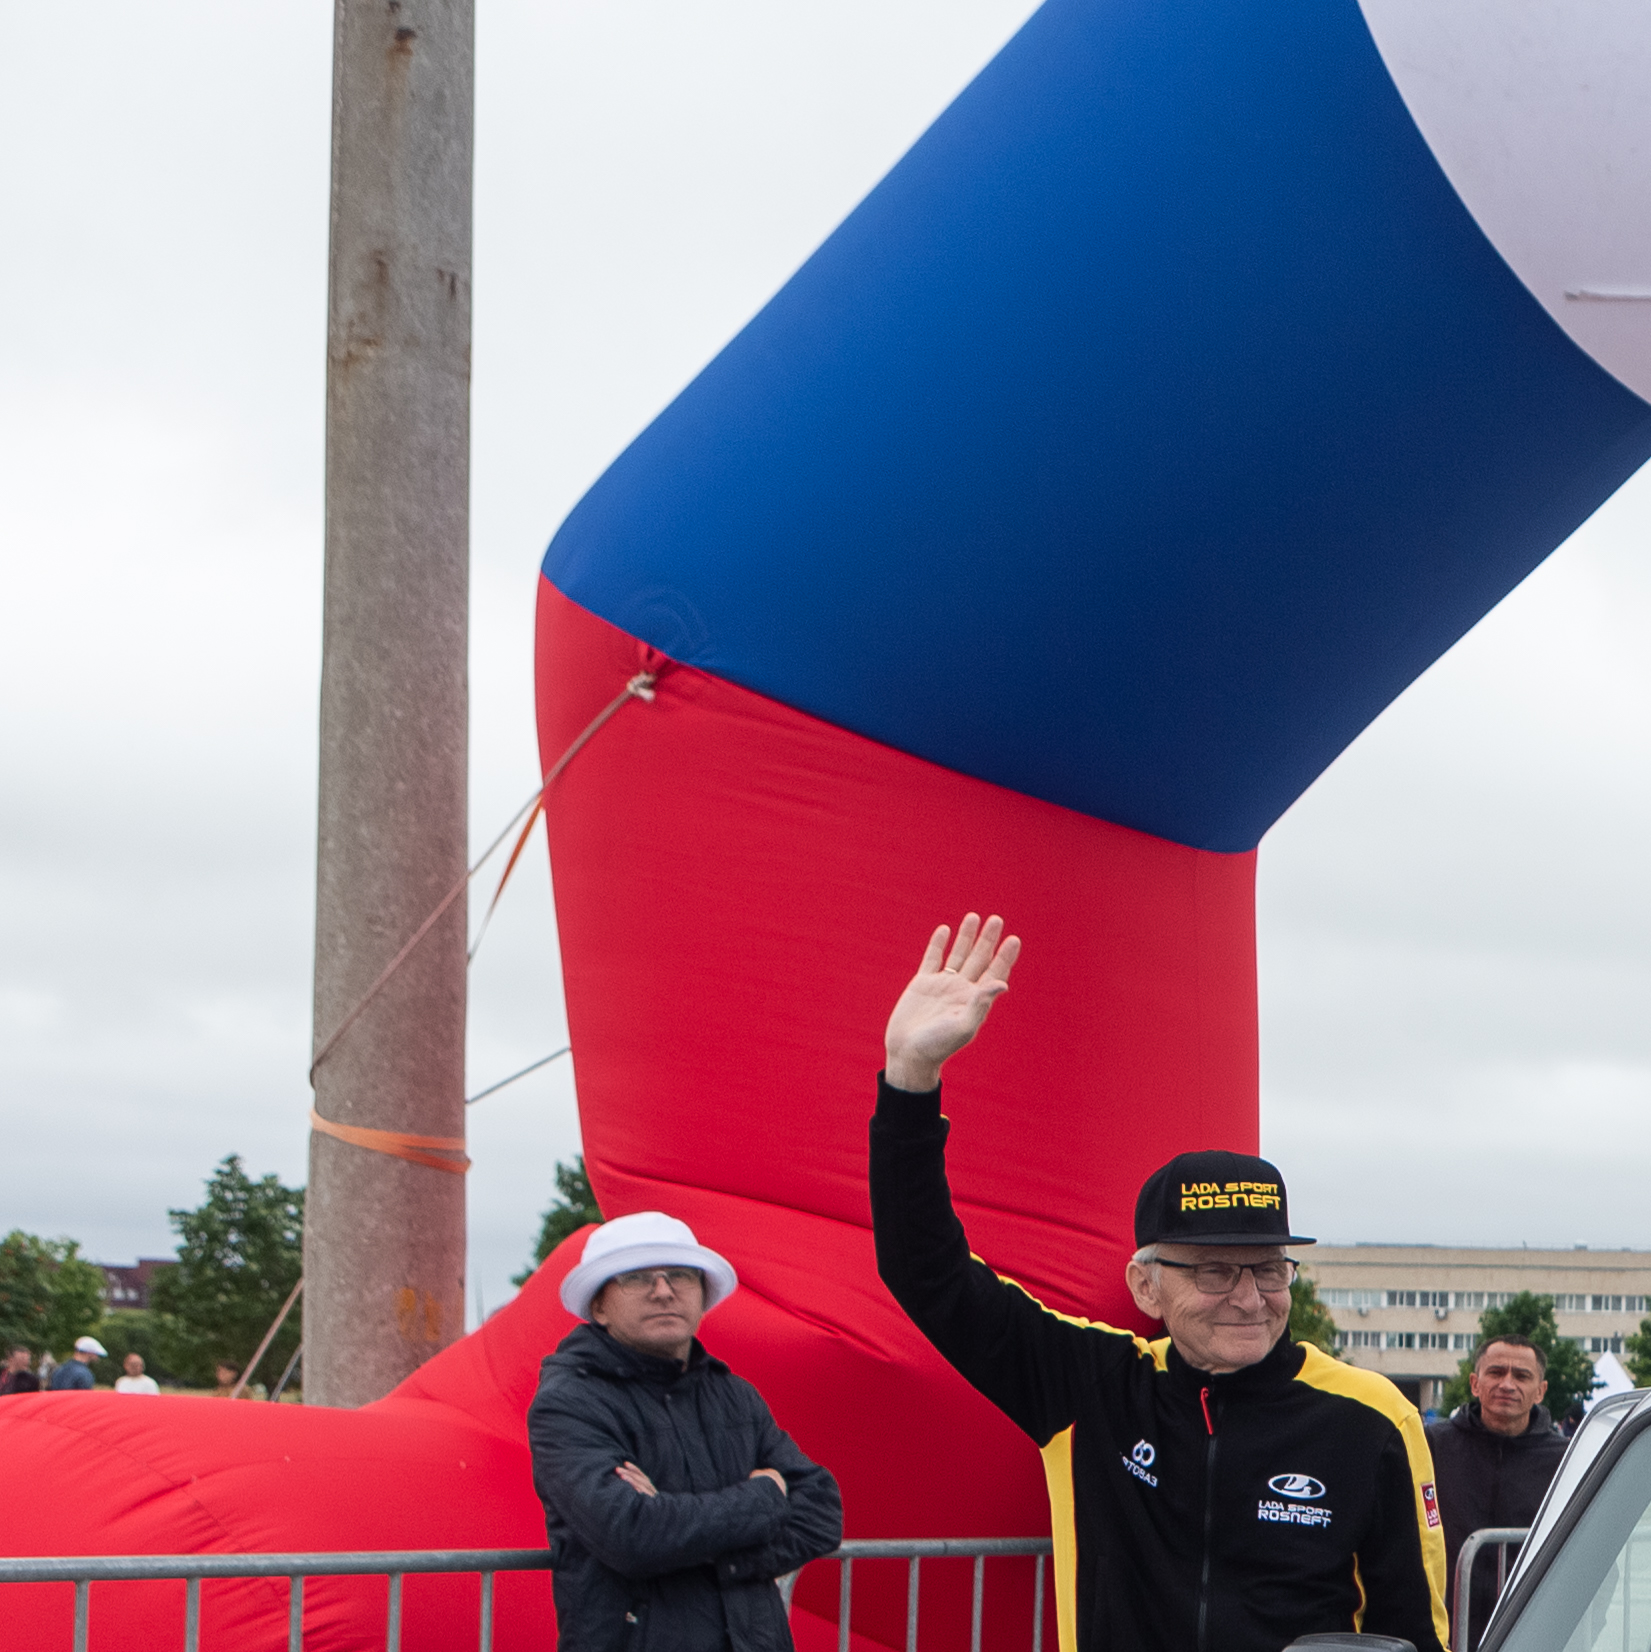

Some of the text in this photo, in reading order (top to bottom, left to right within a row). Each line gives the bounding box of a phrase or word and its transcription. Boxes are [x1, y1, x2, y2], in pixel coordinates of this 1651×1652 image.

[1181, 1181, 1278, 1195] LADA SPORT
[1181, 1193, 1281, 1212] ROSNEFT
[1258, 1500, 1333, 1518] LADA SPORT
[1257, 1509, 1332, 1528] ROSNEFT
